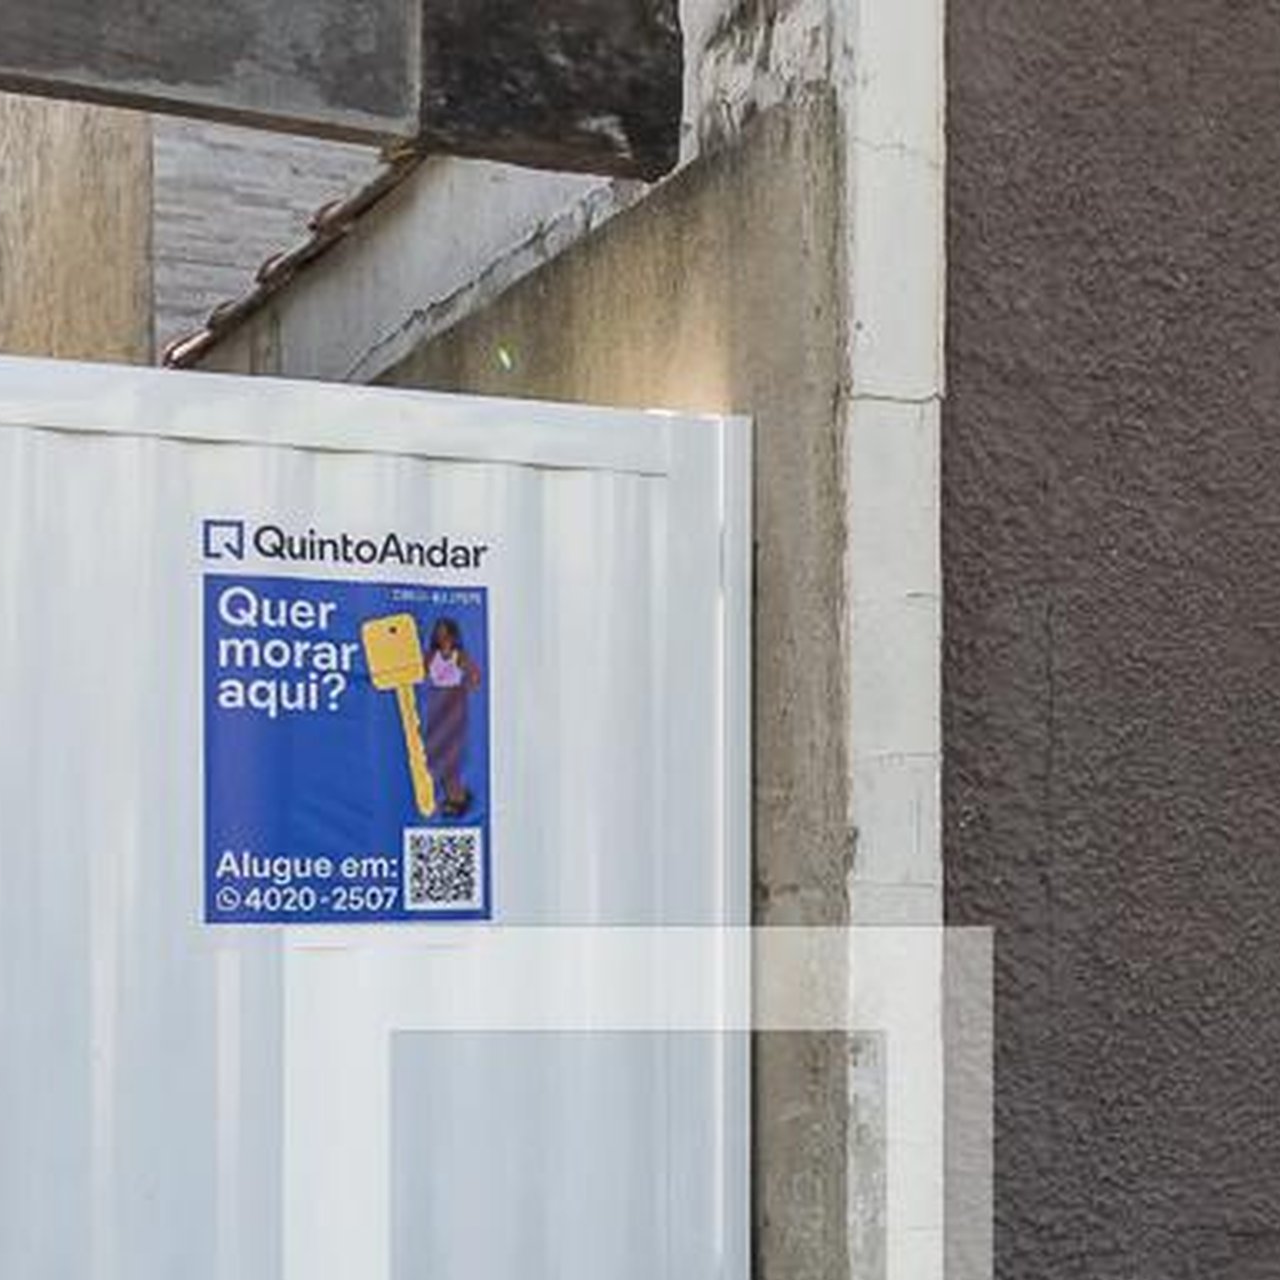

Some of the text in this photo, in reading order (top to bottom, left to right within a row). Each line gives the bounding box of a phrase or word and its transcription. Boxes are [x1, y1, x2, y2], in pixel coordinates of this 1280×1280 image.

[253, 525, 488, 568] QuintoAndar
[218, 586, 337, 629] Quer
[218, 637, 359, 671] morar
[218, 673, 346, 717] aqui?
[216, 851, 399, 884] Alugue em:
[244, 886, 399, 911] 4020-2507
